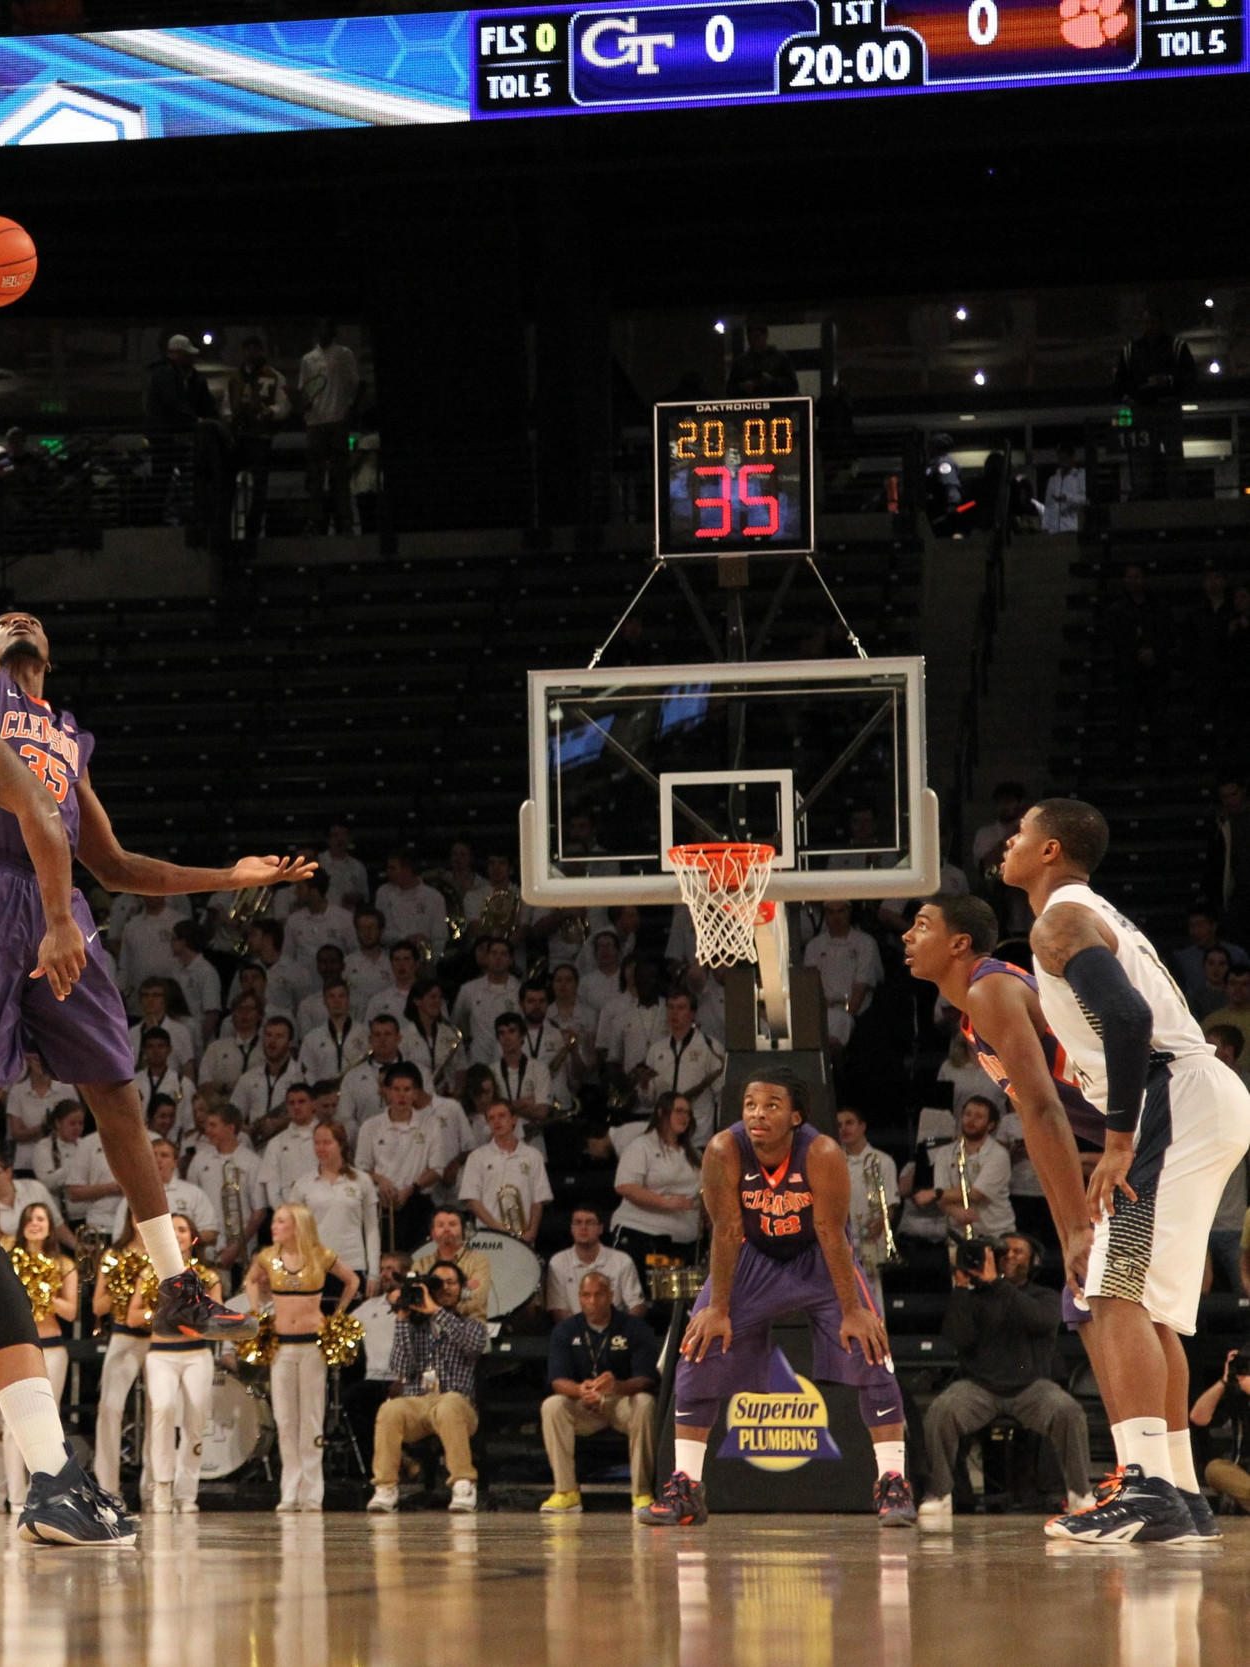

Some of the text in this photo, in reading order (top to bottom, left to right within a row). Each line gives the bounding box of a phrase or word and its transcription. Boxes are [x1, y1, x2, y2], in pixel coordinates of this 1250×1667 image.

[832, 0, 874, 26] 1ST
[968, 0, 998, 45] 0
[481, 23, 556, 55] FLS 0
[705, 14, 735, 62] 0
[1157, 29, 1227, 57] TOL 5
[789, 41, 911, 87] 20:00
[486, 73, 551, 99] TOL 5
[696, 402, 770, 413] DAKTRONICS
[693, 463, 780, 538] 35
[19, 743, 69, 804] 35
[735, 1397, 819, 1424] Superior
[738, 1428, 819, 1452] PLUMBING
